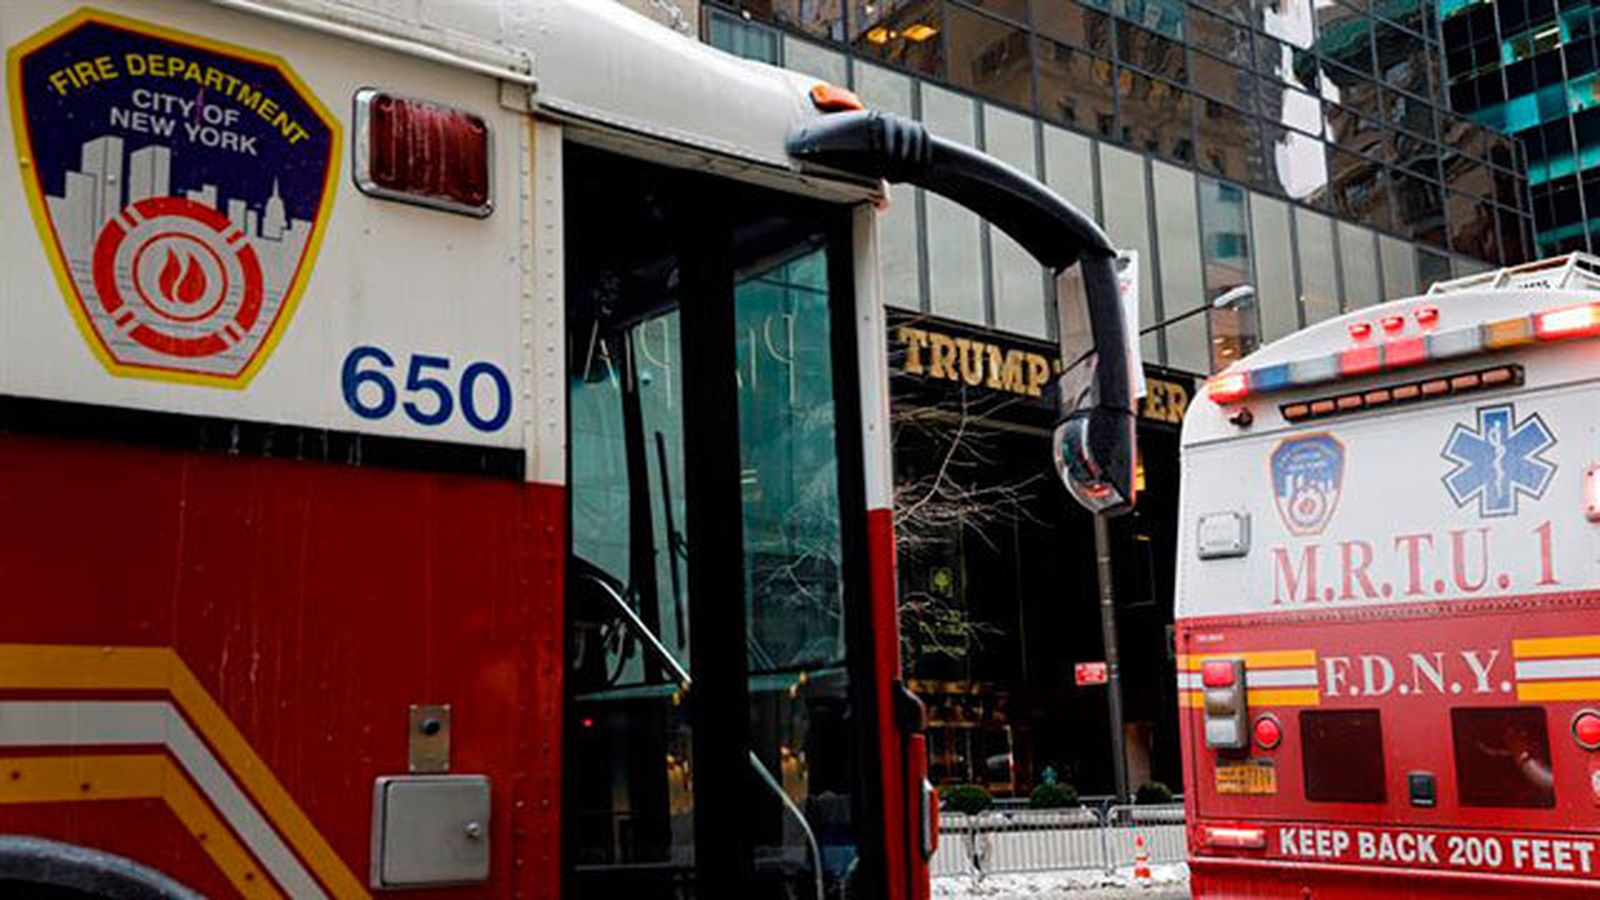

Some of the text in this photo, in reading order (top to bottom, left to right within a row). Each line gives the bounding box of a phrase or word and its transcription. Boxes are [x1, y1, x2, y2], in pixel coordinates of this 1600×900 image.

[48, 53, 310, 145] FIRE DEPARTMENT
[131, 88, 240, 126] CITY OF
[109, 106, 258, 157] NEW YORK
[341, 346, 512, 432] 650
[894, 325, 1050, 397] TRUMP
[1271, 519, 1560, 605] M.R.T.U. 1
[1320, 649, 1512, 697] F.D.N.Y.
[1279, 827, 1595, 873] KEEP BACK 200 FEET
